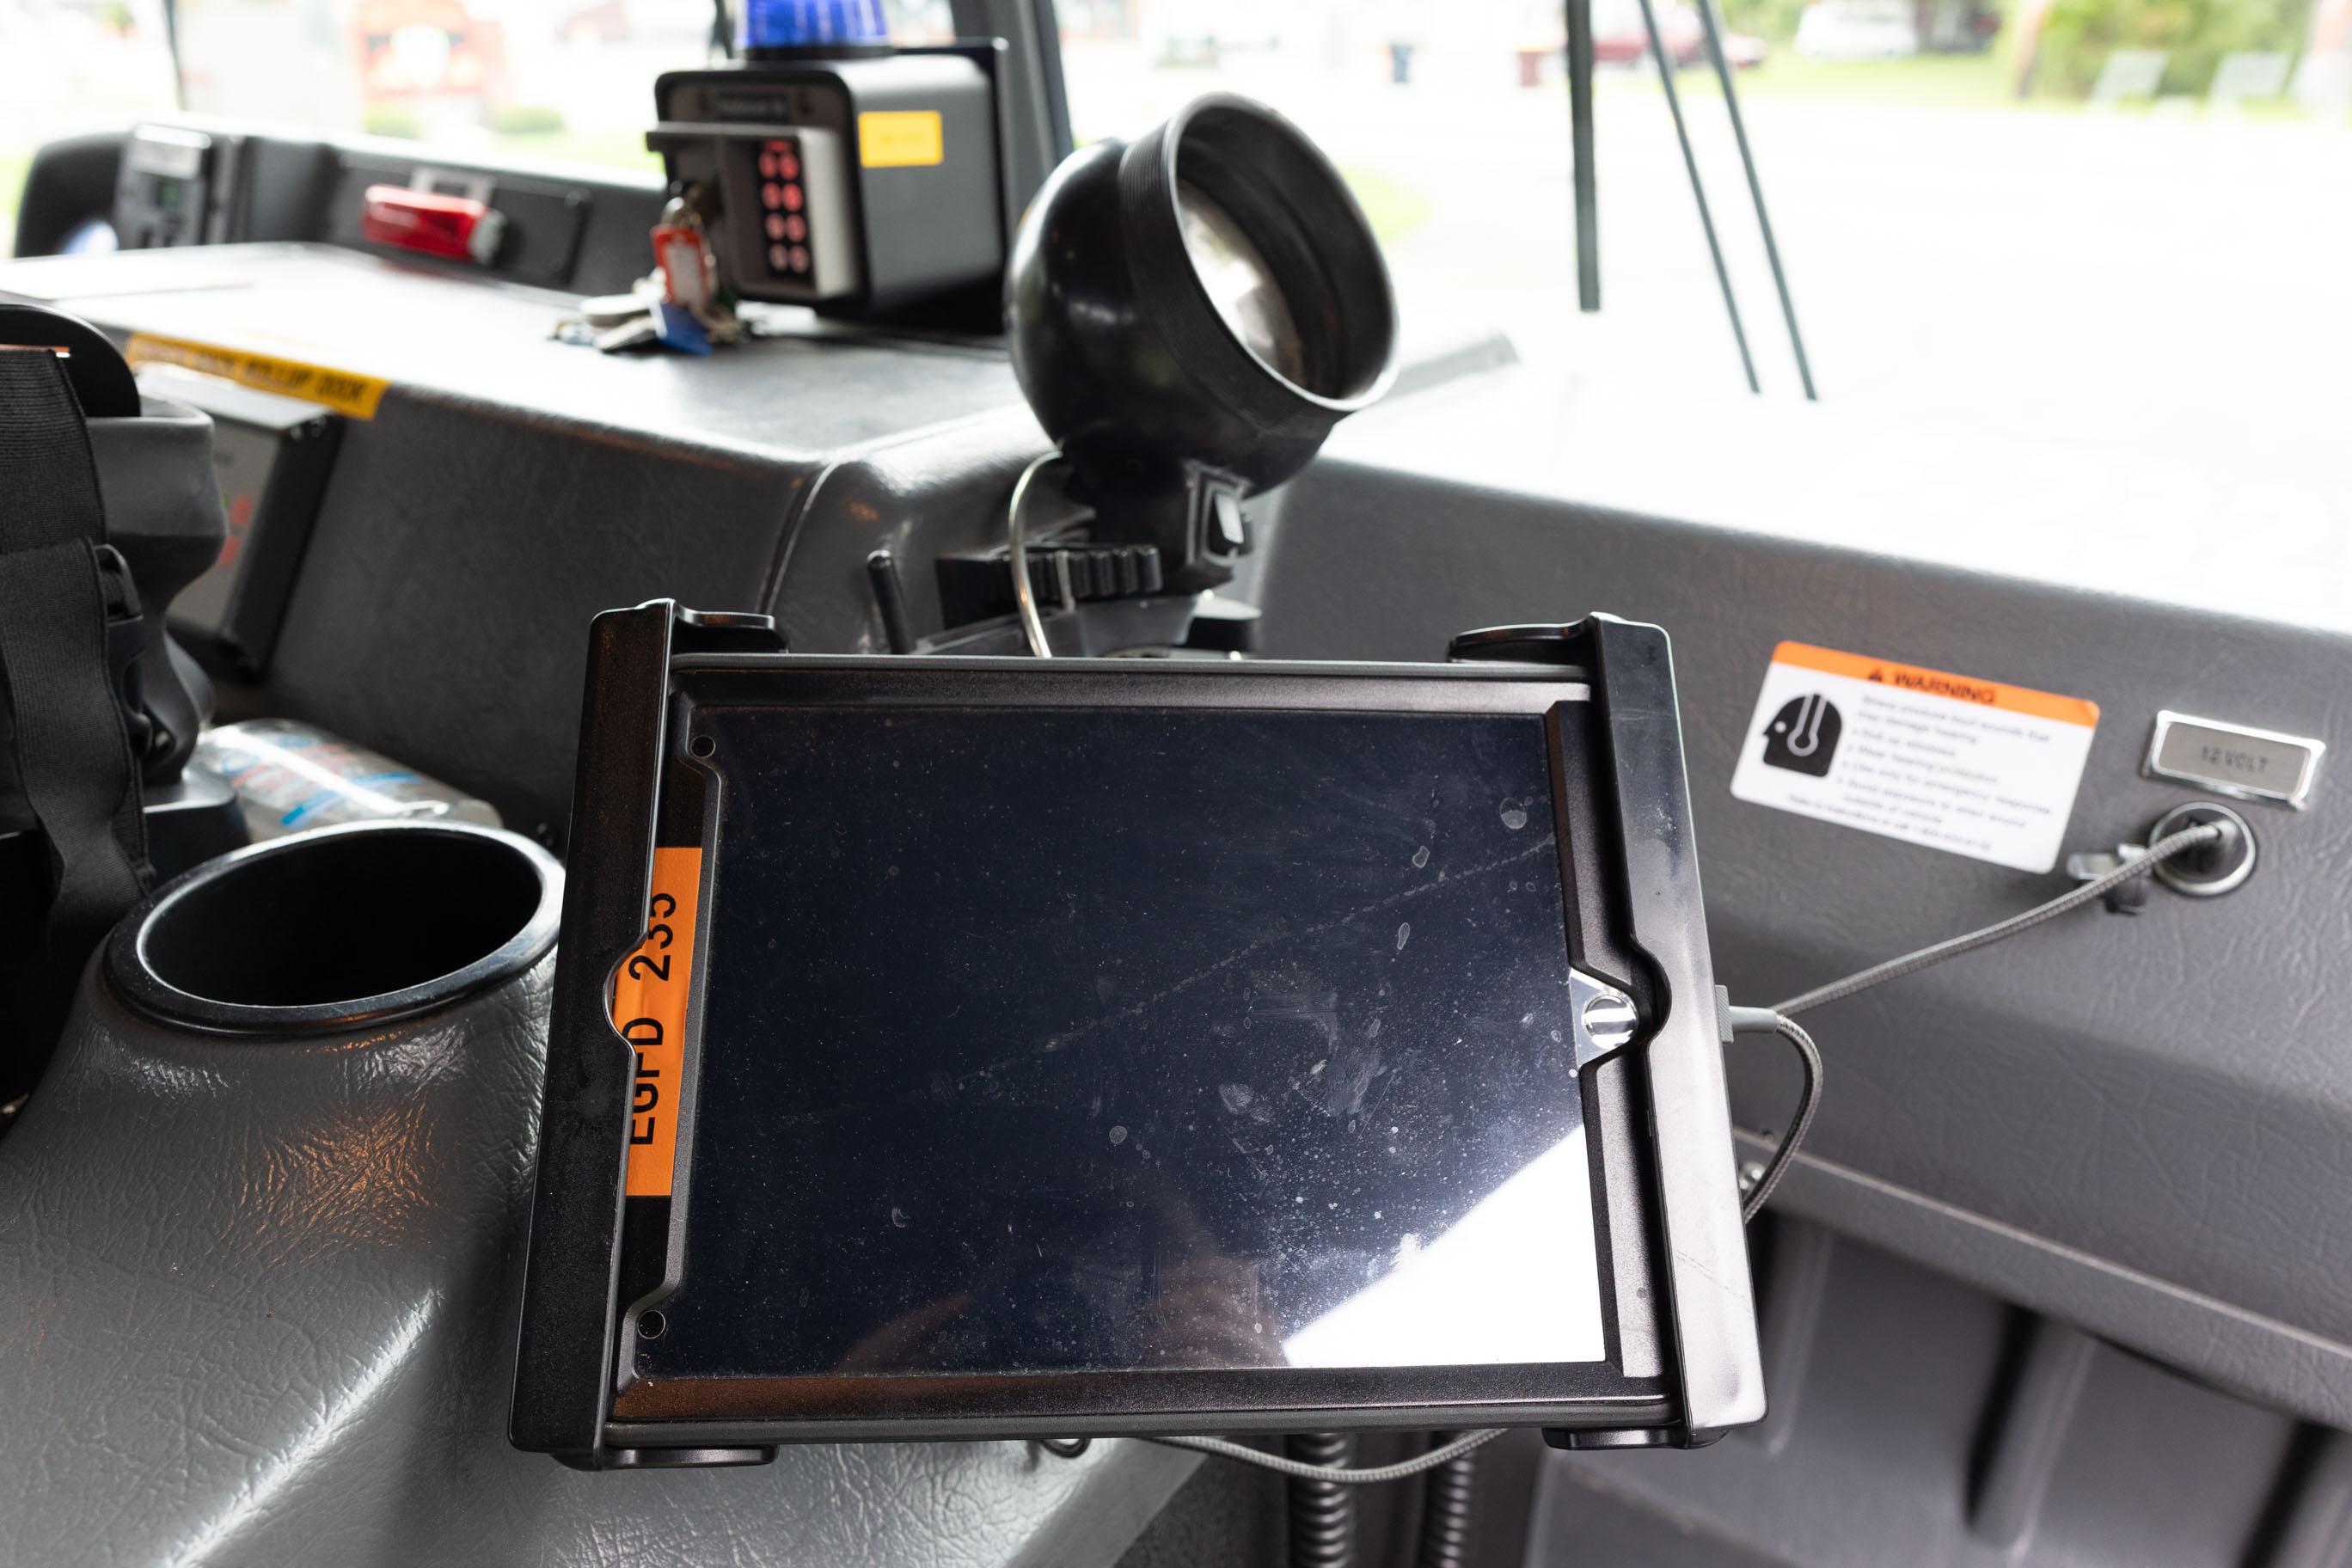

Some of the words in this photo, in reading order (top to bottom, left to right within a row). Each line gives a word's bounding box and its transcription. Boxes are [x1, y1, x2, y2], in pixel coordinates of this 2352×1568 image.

[1894, 672, 1995, 704] WARNING
[2201, 746, 2221, 764] 12
[2226, 751, 2269, 772] VOLT
[628, 893, 676, 981] 235
[622, 1018, 664, 1144] EGFD
